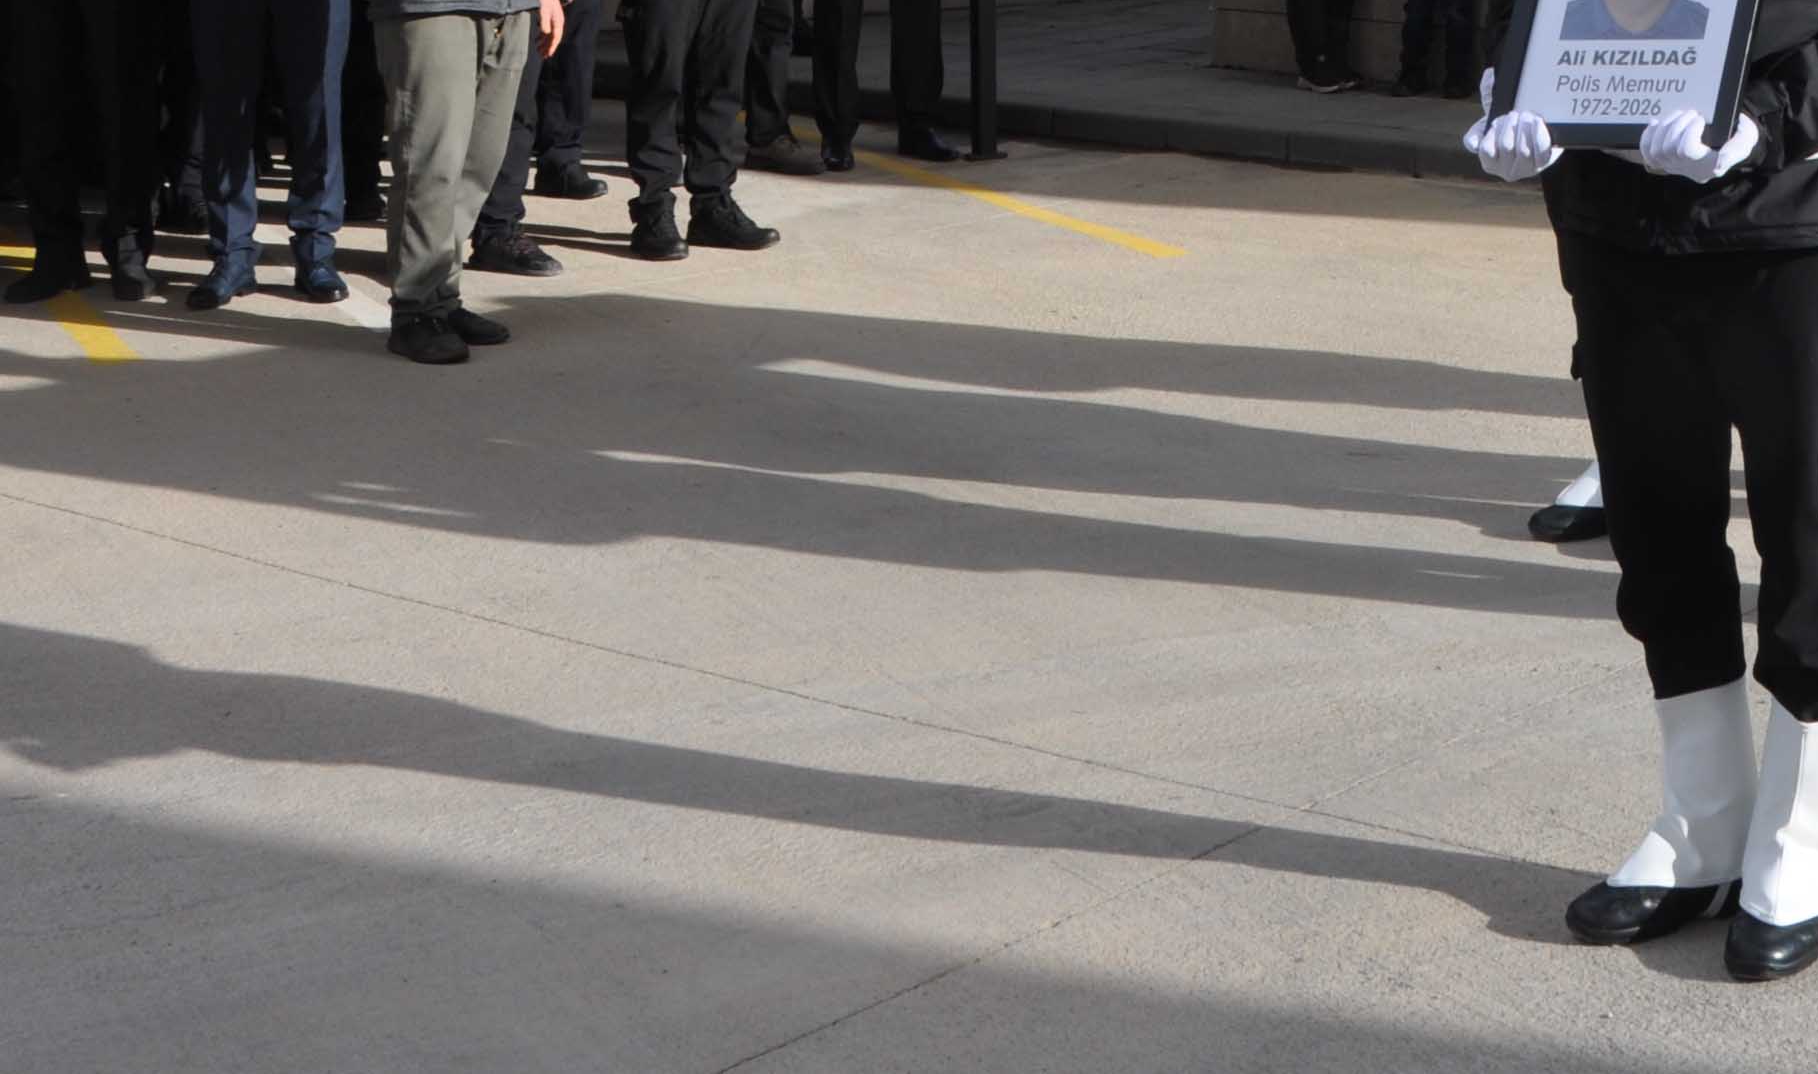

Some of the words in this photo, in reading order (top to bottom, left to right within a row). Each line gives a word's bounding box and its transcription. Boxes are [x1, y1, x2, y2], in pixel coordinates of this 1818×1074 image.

[1556, 49, 1587, 66] Ali
[1592, 46, 1697, 66] KIZILDAĞ
[1555, 75, 1601, 93] Polis
[1605, 75, 1687, 93] Memuru
[1570, 98, 1662, 116] 1972-2026
